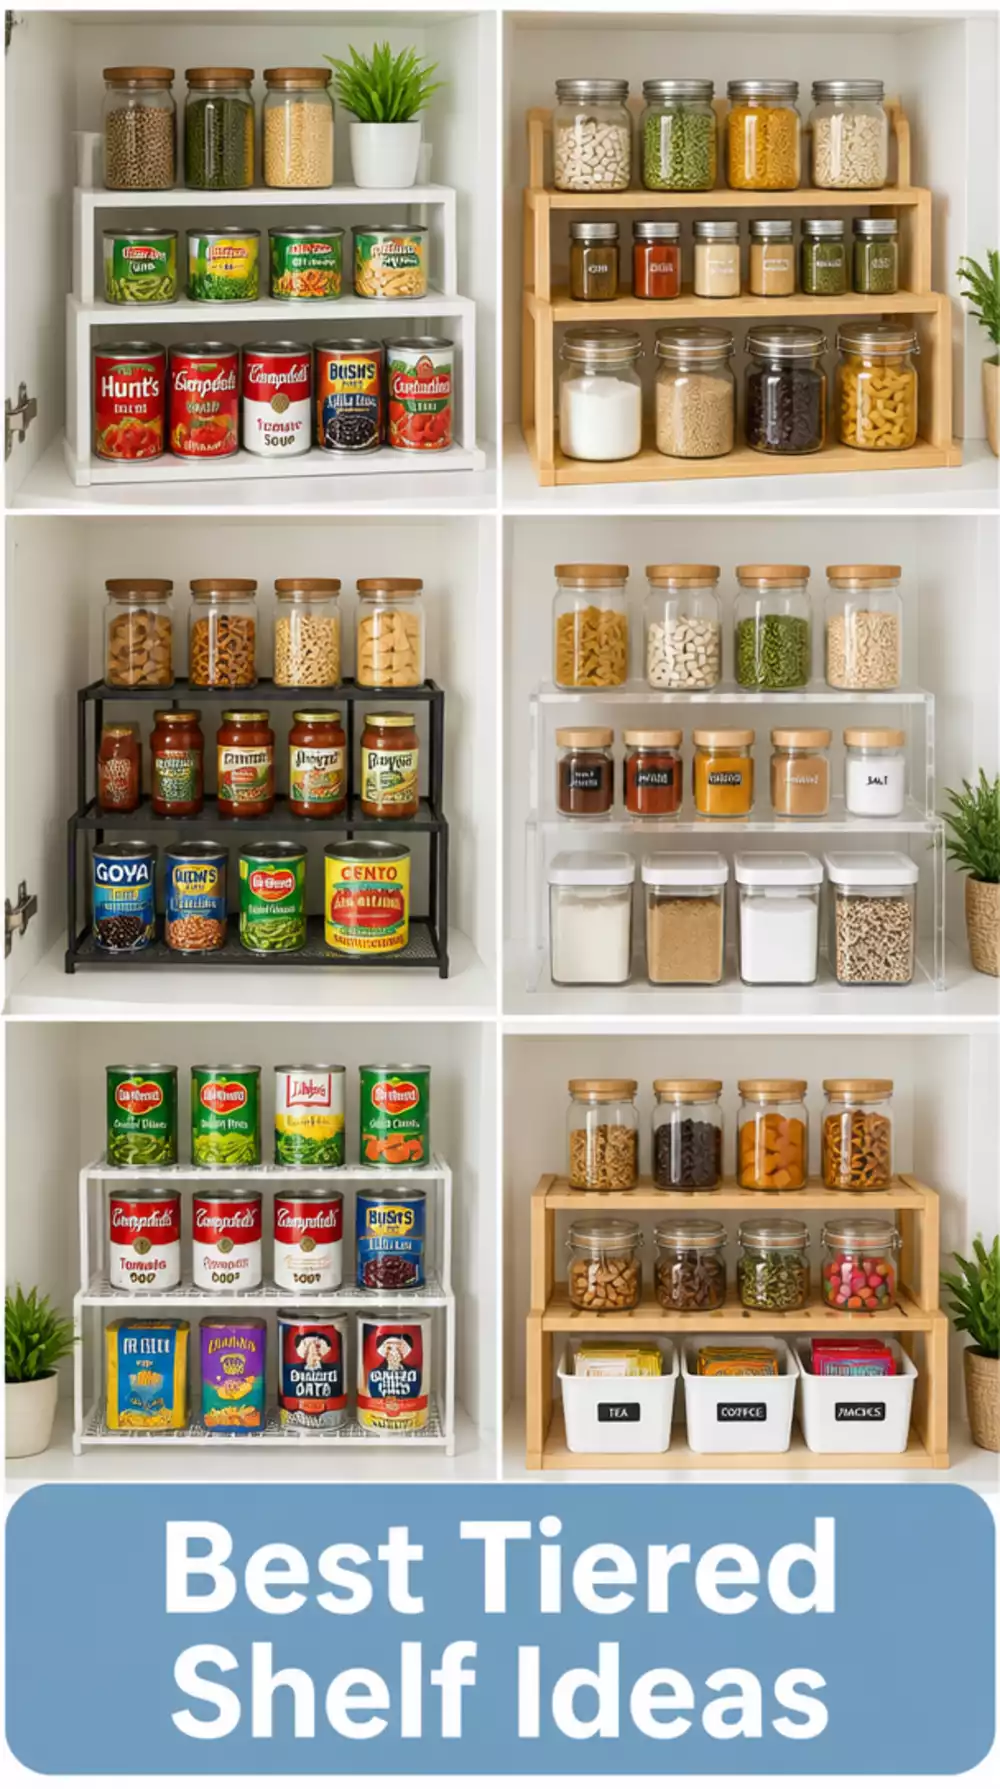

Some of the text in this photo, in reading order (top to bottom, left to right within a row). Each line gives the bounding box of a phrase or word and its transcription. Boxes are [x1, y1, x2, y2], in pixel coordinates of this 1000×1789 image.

[101, 376, 160, 398] Hunt's
[96, 862, 149, 882] GOYA
[341, 866, 398, 881] CENTO
[609, 1407, 629, 1418] TEA
